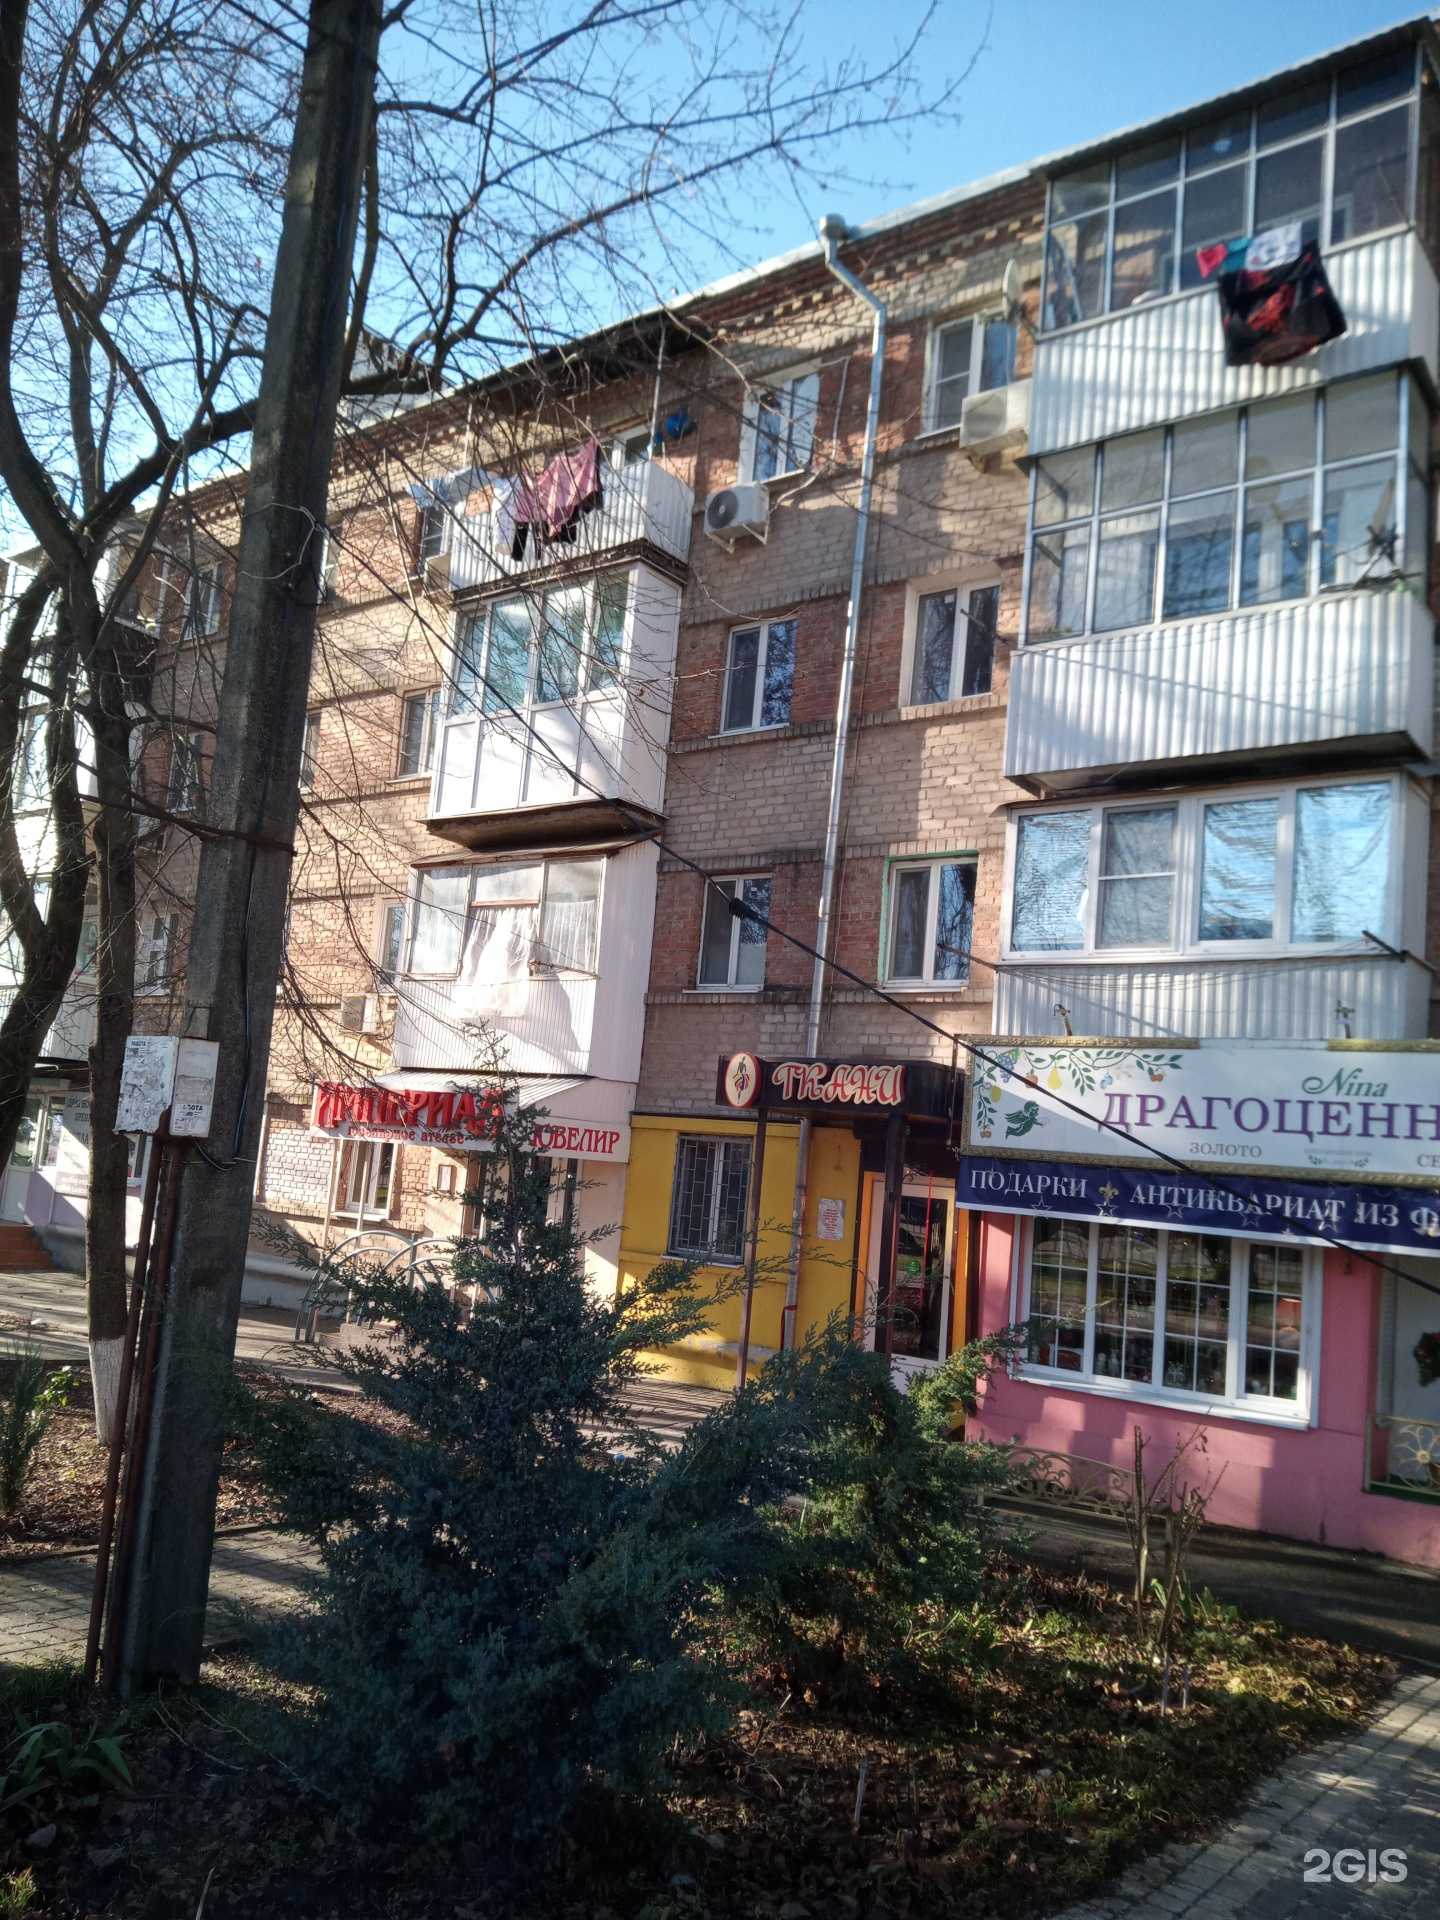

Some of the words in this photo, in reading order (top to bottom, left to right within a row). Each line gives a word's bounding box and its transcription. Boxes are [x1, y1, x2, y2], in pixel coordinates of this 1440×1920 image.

[772, 1062, 906, 1106] ТКАНИ
[1302, 1067, 1388, 1097] Nina
[1098, 1093, 1440, 1143] ДРАГОЦЕНН
[533, 1124, 620, 1154] ЮВЕЛИР
[1190, 1142, 1262, 1158] ЗОЛОТО
[970, 1170, 1088, 1198] ПОДАРКИ
[1356, 1202, 1399, 1227] ИЗ
